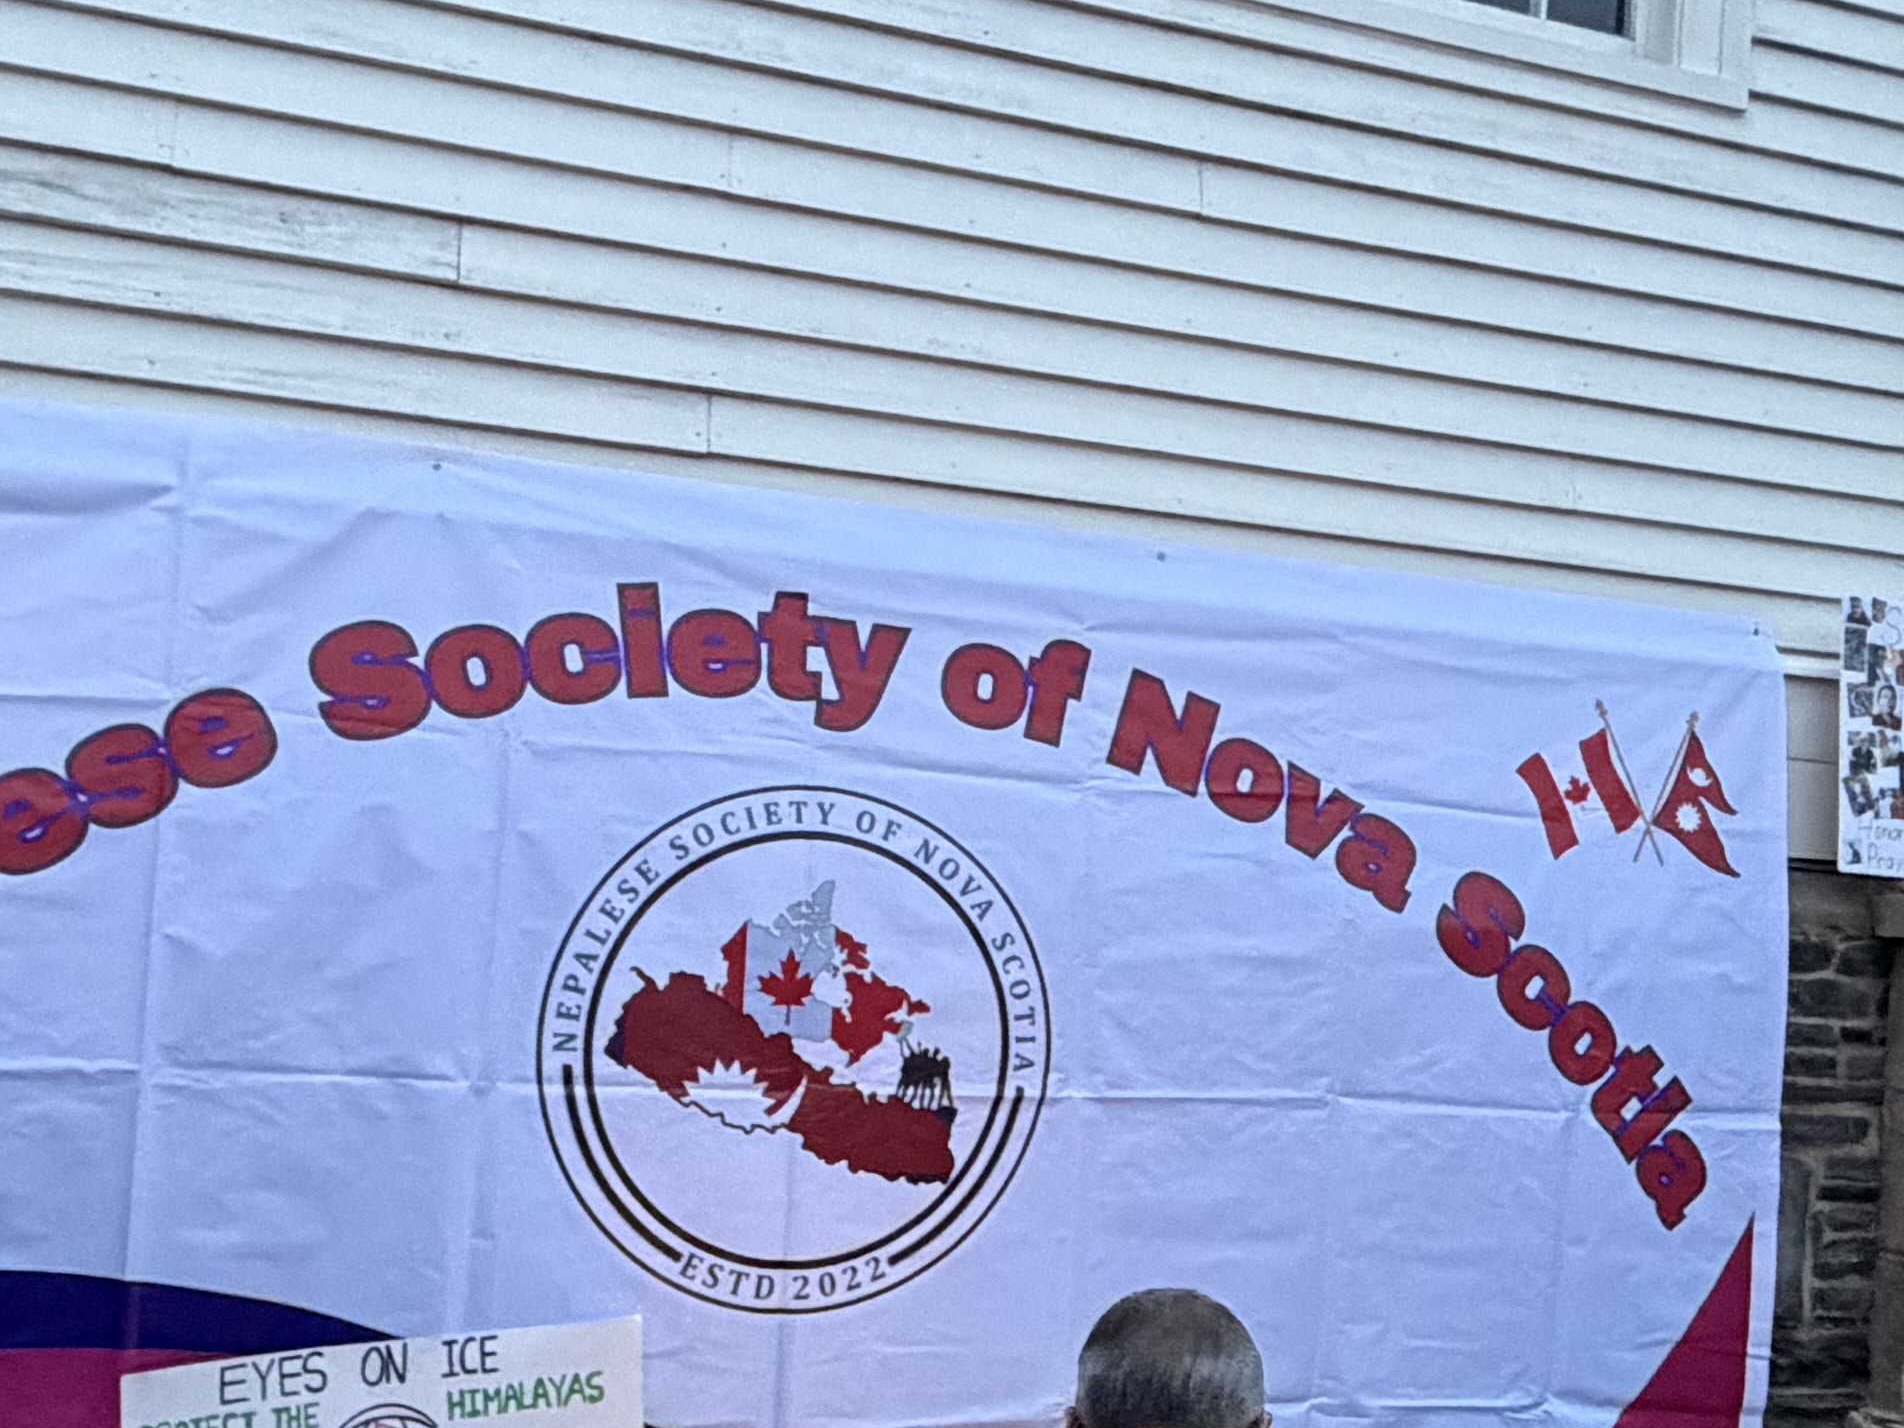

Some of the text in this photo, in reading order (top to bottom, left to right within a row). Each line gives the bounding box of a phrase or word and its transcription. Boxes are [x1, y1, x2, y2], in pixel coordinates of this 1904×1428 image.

[308, 582, 911, 741] Society
[941, 638, 1091, 748] of
[1105, 667, 1417, 914] Nova
[1435, 871, 1708, 1230] Scotia
[552, 800, 1037, 1073] NEPALESE SOCIETY OF NOVA SCOTIA
[678, 1252, 888, 1301] ESTD 2022
[218, 1335, 499, 1406] EYES ON ICE
[445, 1370, 606, 1422] HIMALAYAS
